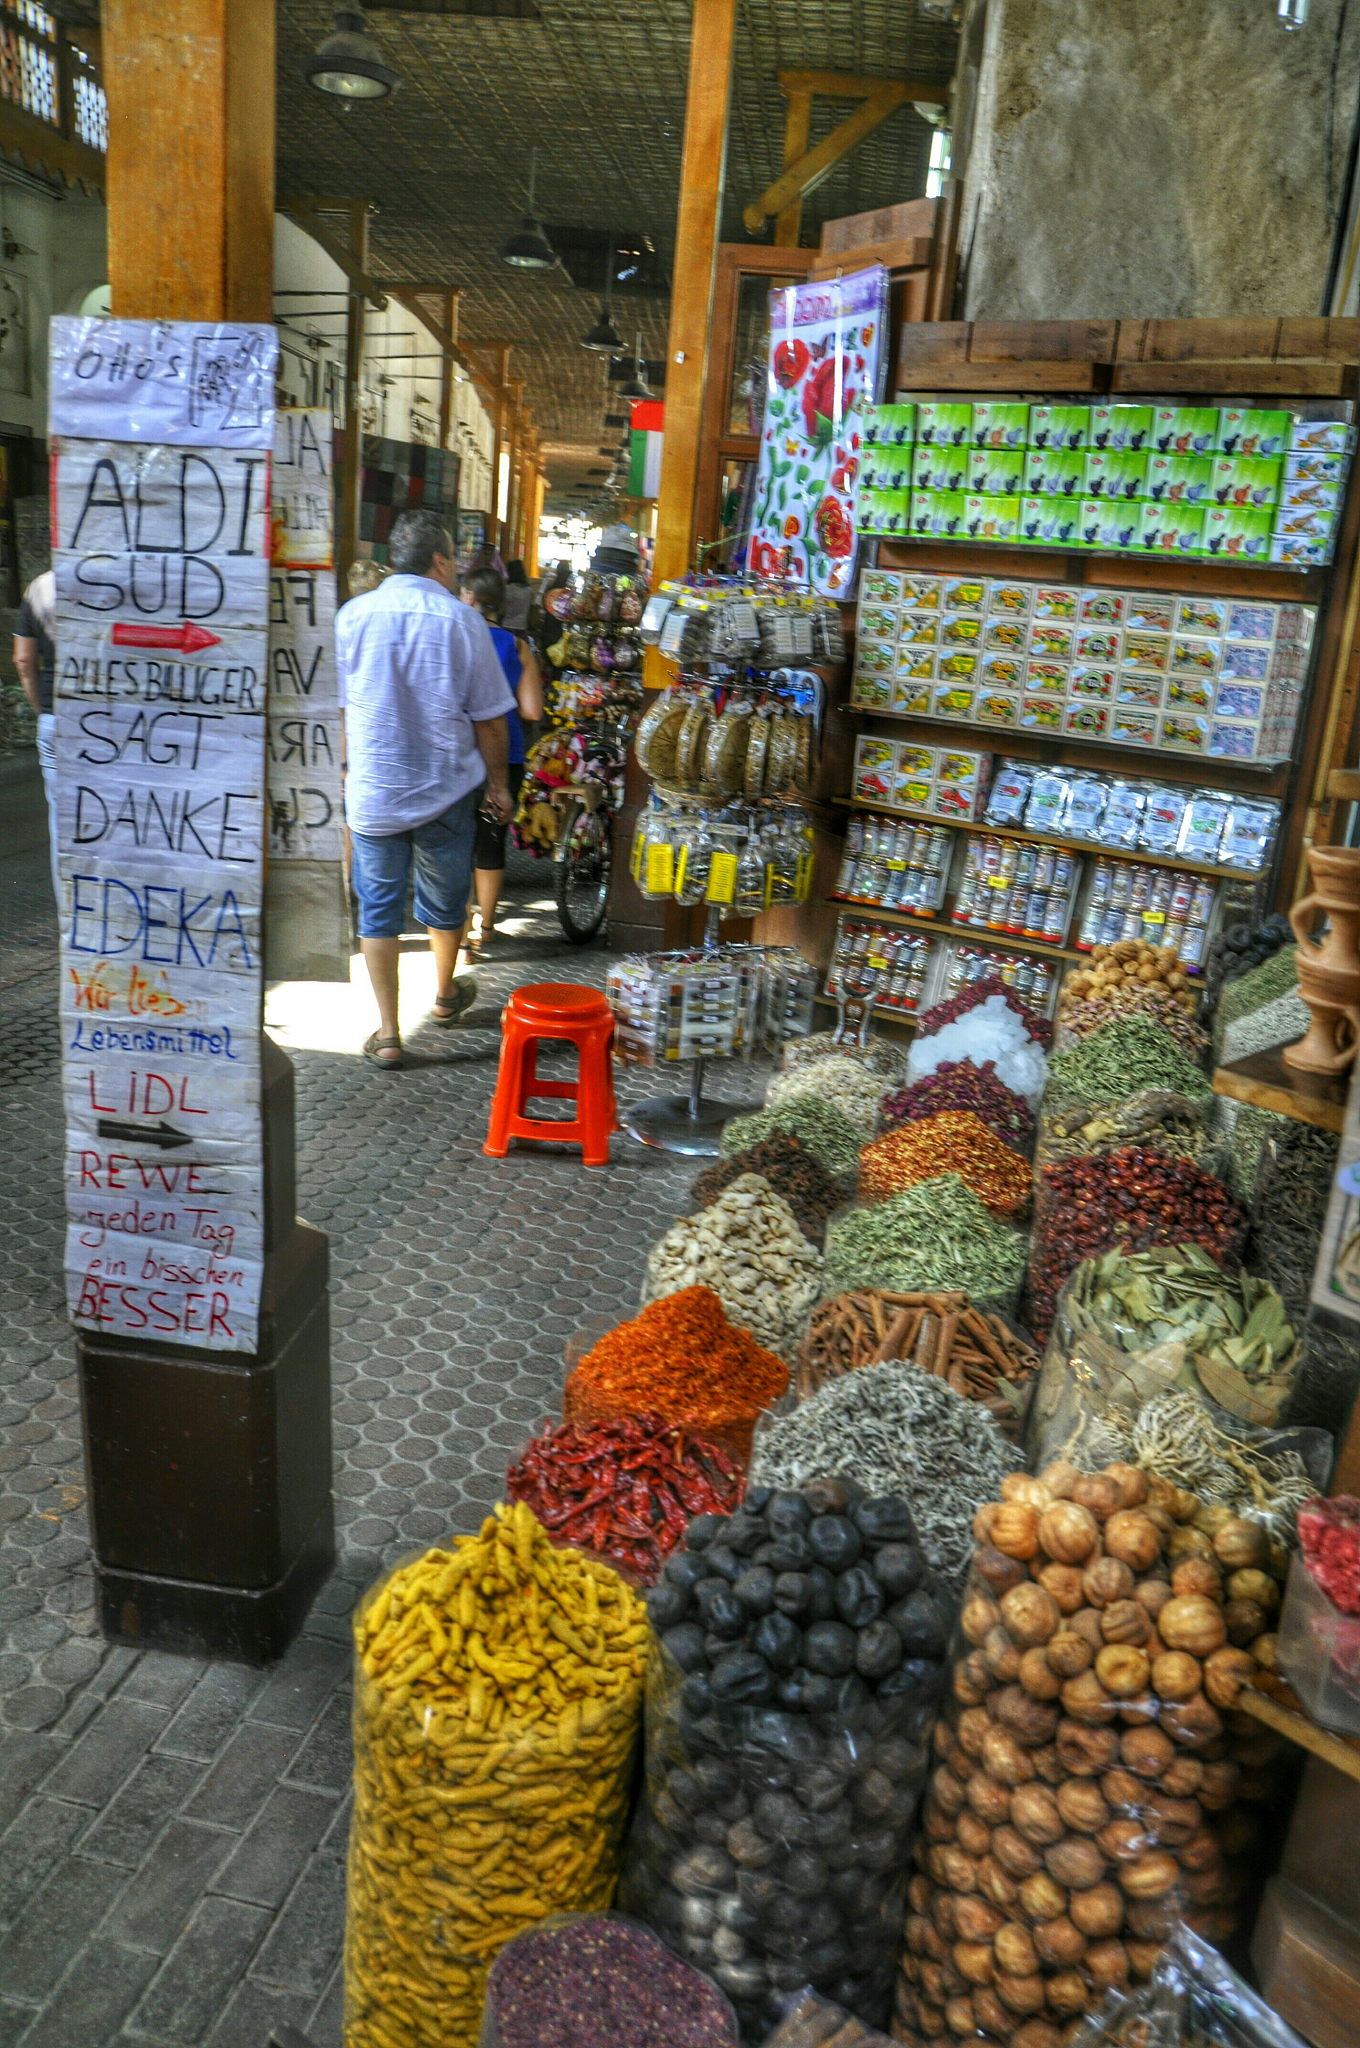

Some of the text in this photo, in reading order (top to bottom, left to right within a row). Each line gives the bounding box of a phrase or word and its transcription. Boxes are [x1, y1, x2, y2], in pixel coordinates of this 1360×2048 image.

[69, 452, 266, 556] ALDI
[58, 656, 257, 708] ALLES BILLIGER
[78, 710, 224, 770] SAGT
[72, 786, 258, 862] DANKE
[70, 874, 252, 968] EDEKA
[70, 1020, 238, 1059] Lebensmittel
[79, 1150, 210, 1194] REWE
[80, 1200, 236, 1259] jeden Tag
[87, 1247, 244, 1287] ein bisschen
[77, 1277, 234, 1337] BESSER
